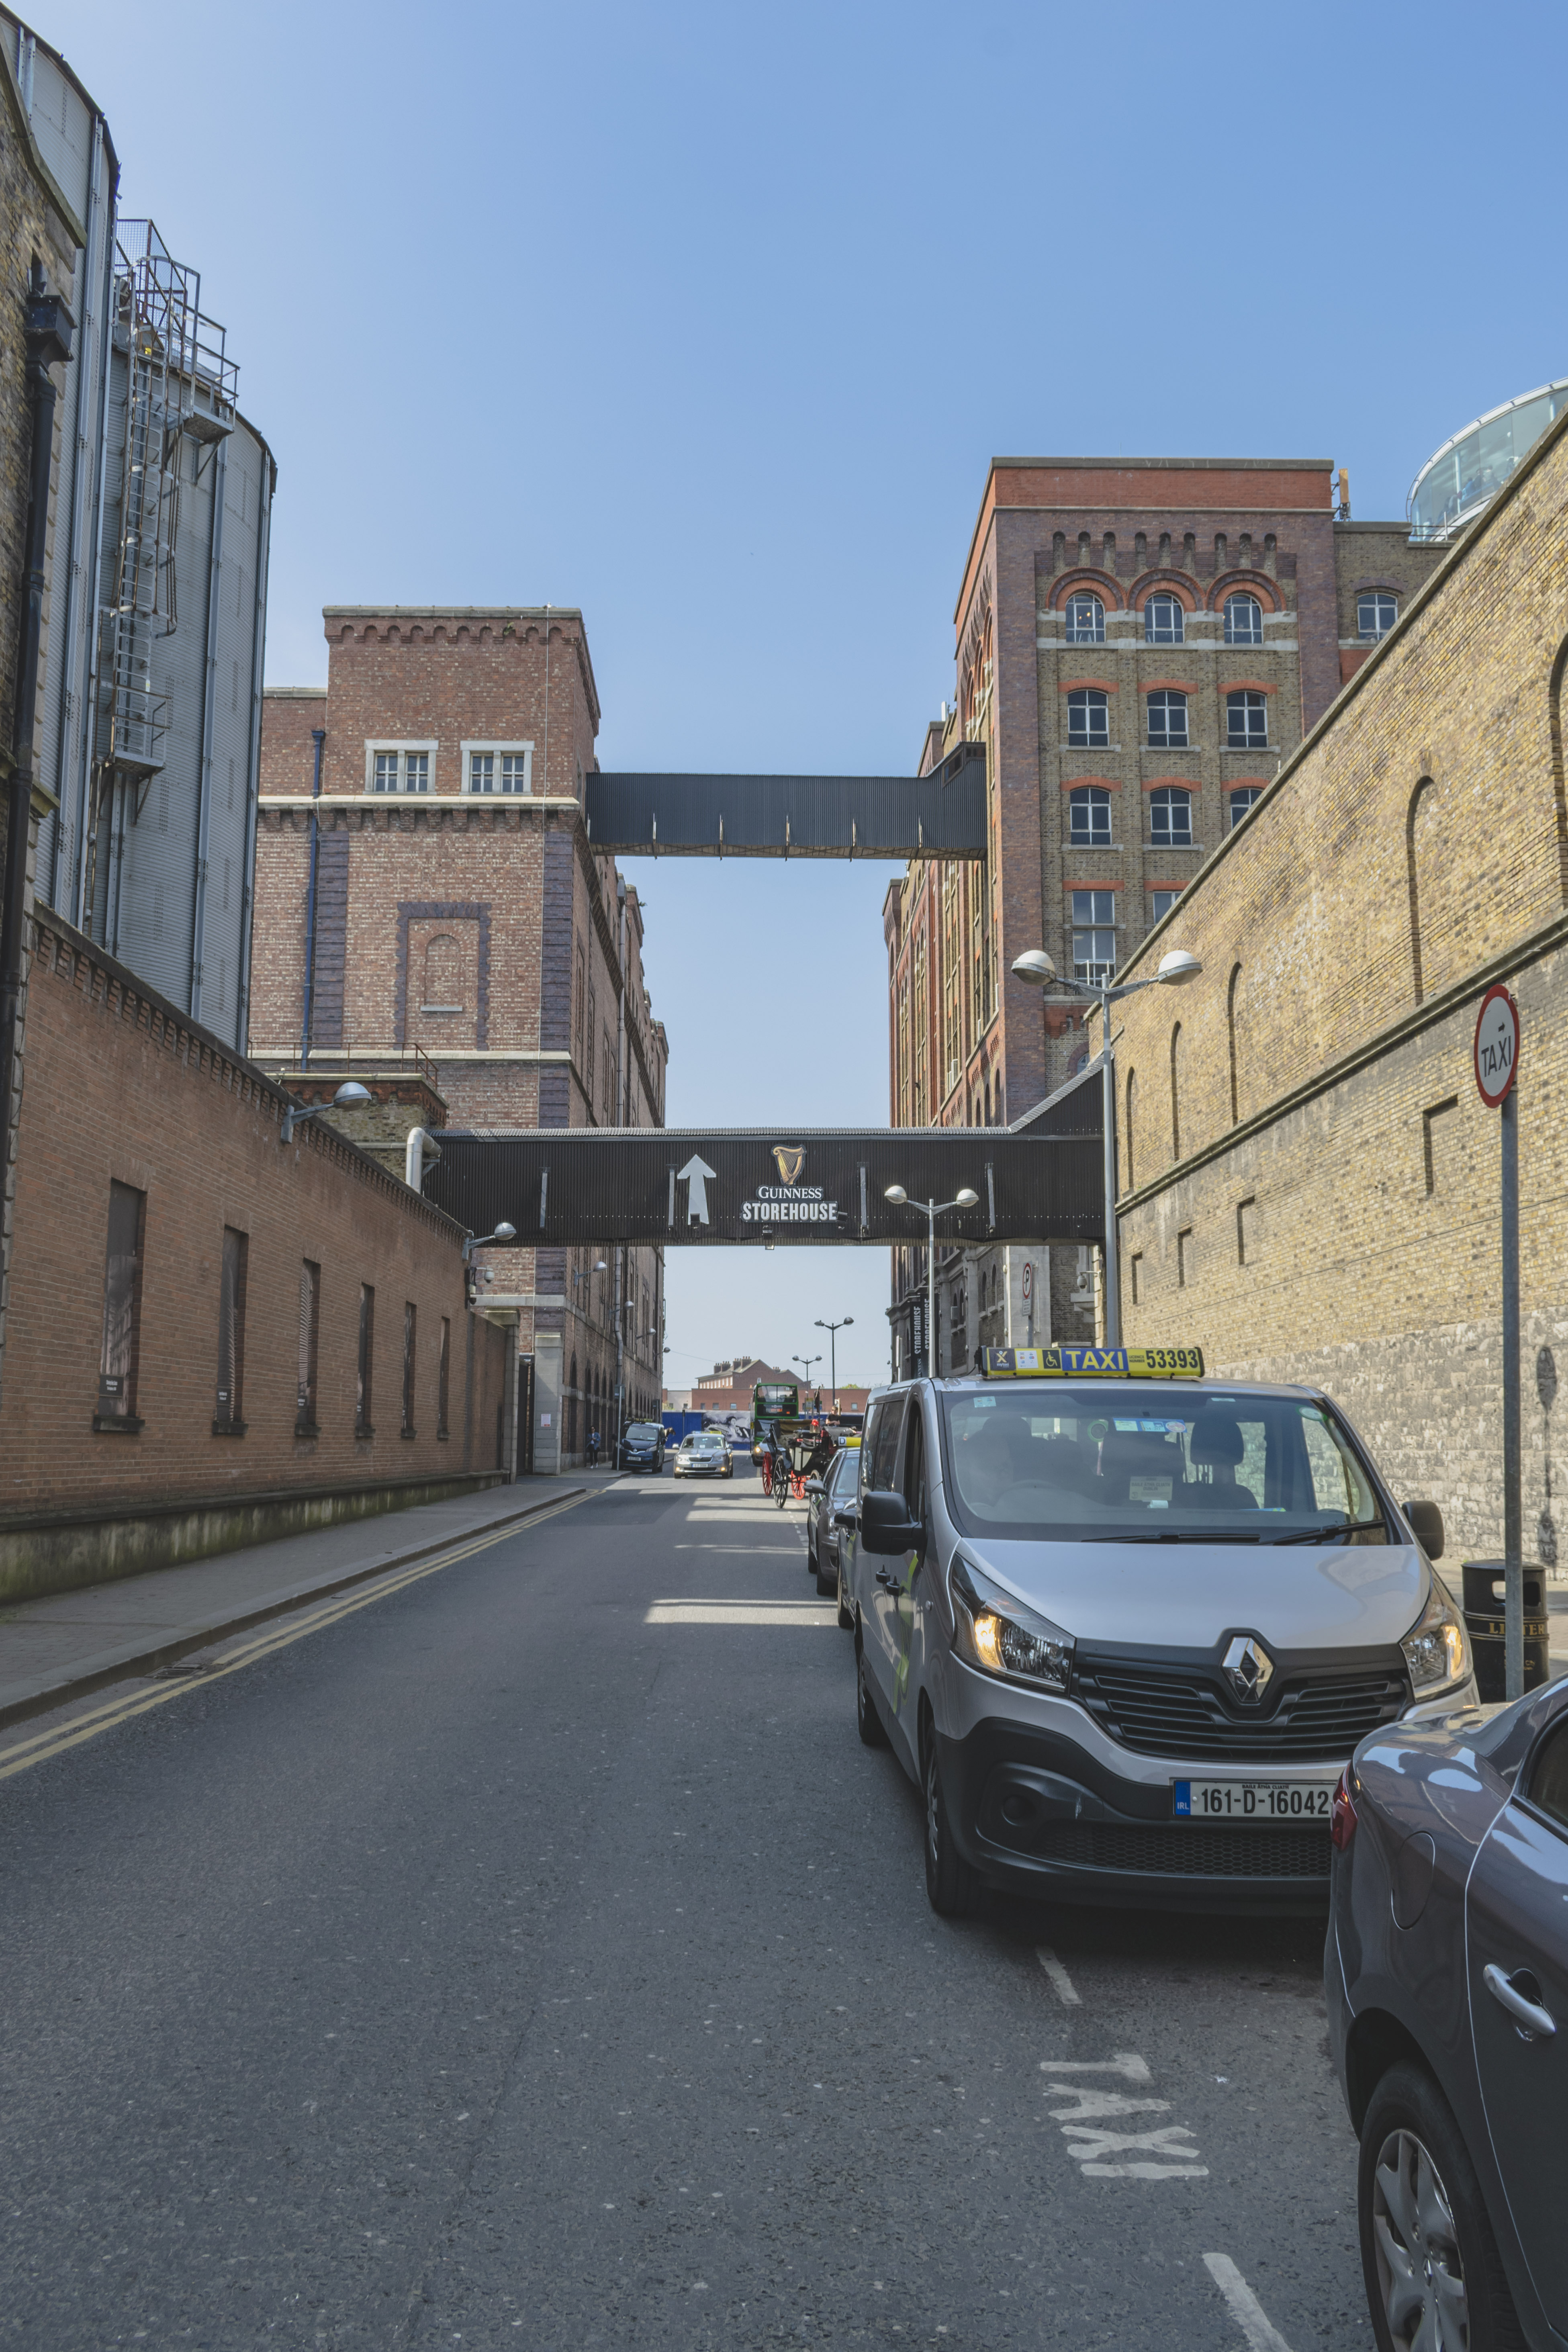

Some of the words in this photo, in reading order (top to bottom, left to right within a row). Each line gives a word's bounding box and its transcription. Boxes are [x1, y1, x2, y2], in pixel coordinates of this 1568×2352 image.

[1481, 1035, 1511, 1078] TAXI
[758, 1186, 822, 1198] GUINNESS
[743, 1203, 837, 1221] STOREHOUSE
[1026, 1270, 1030, 1292] P
[1065, 1351, 1124, 1370] TAXI
[1145, 1350, 1198, 1368] 53393
[1489, 1622, 1545, 1635] LITER
[1177, 1802, 1190, 1810] IRL
[1201, 1788, 1329, 1815] 161-D-16042
[1039, 2053, 1209, 2179] TAXI
